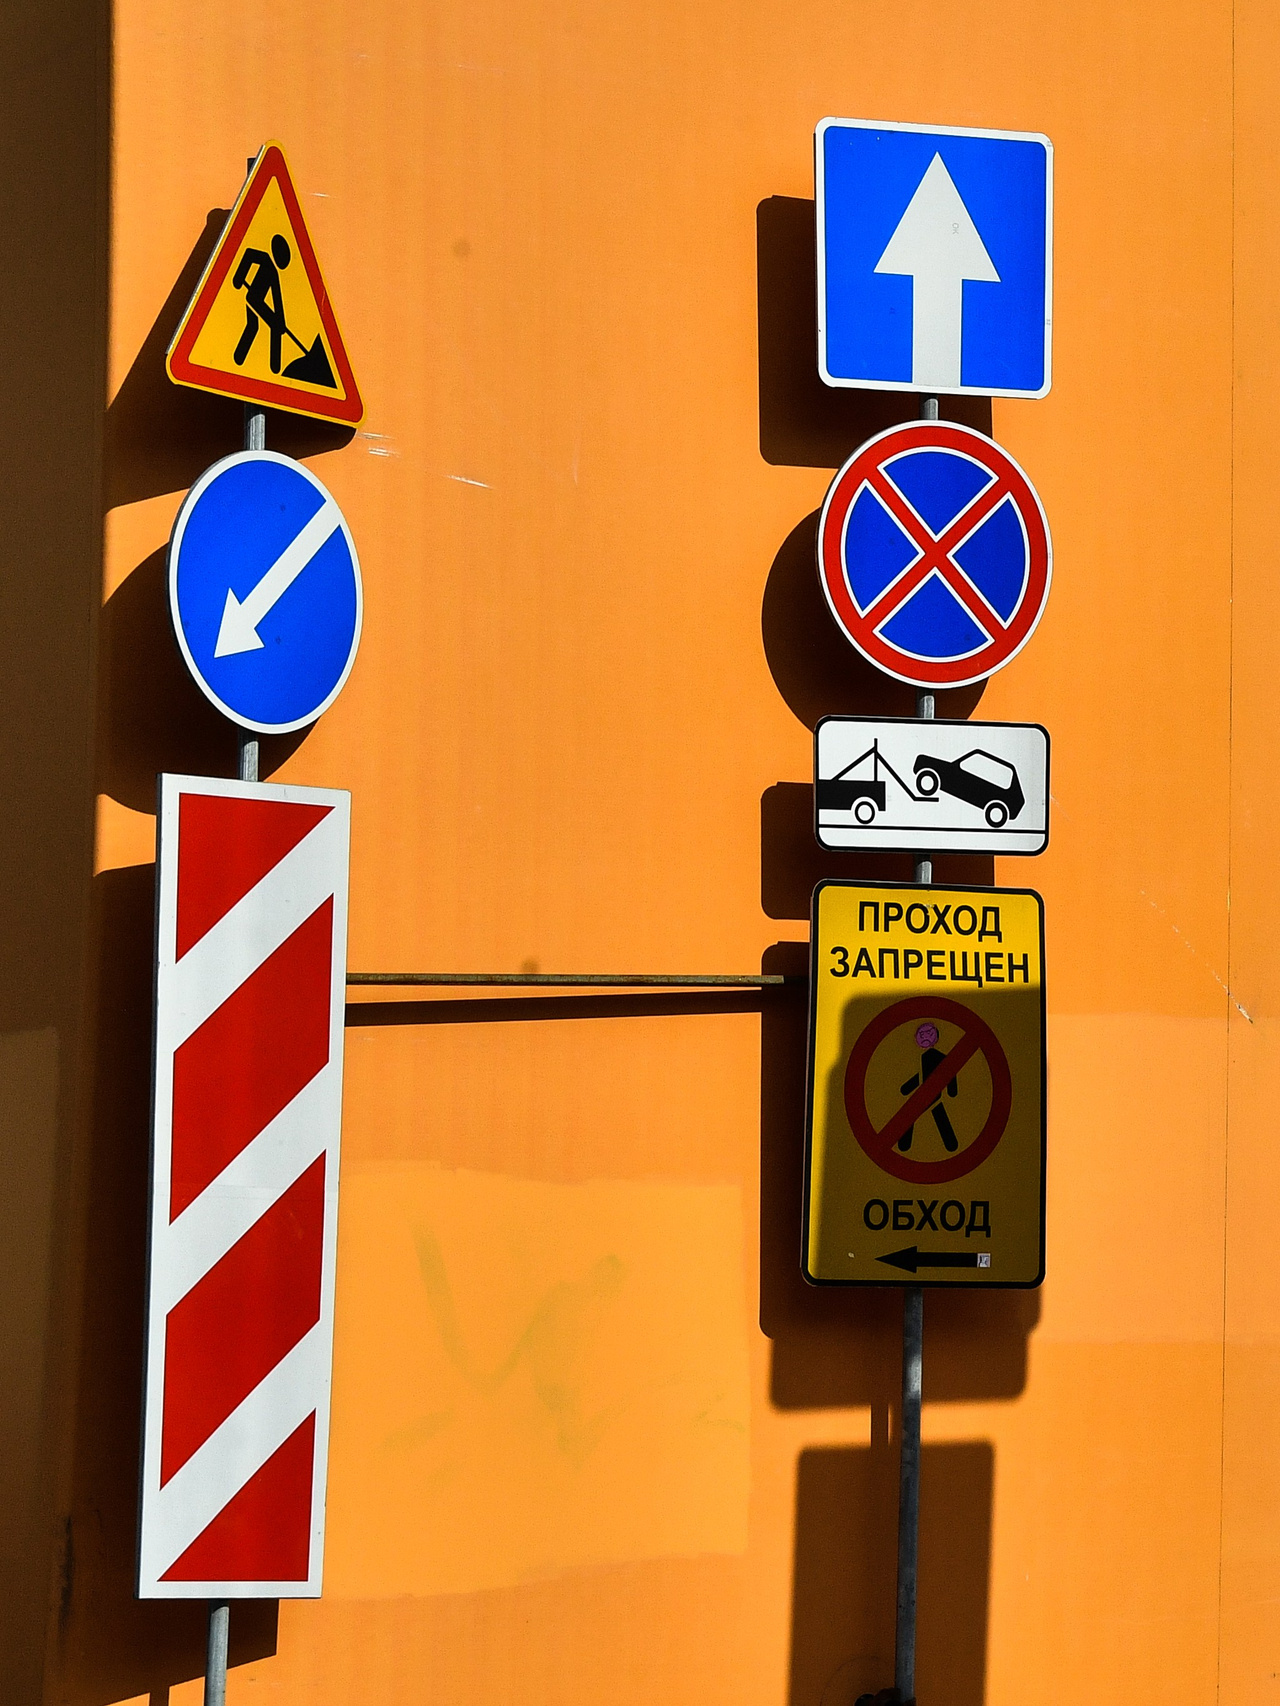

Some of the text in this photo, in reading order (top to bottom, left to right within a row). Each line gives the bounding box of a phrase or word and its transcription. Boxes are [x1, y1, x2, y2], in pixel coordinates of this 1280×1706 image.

[858, 900, 1003, 943] ПРОХОД
[829, 946, 1029, 988] ЗАПРЕЩЕН
[863, 1198, 991, 1238] ОБХОД
